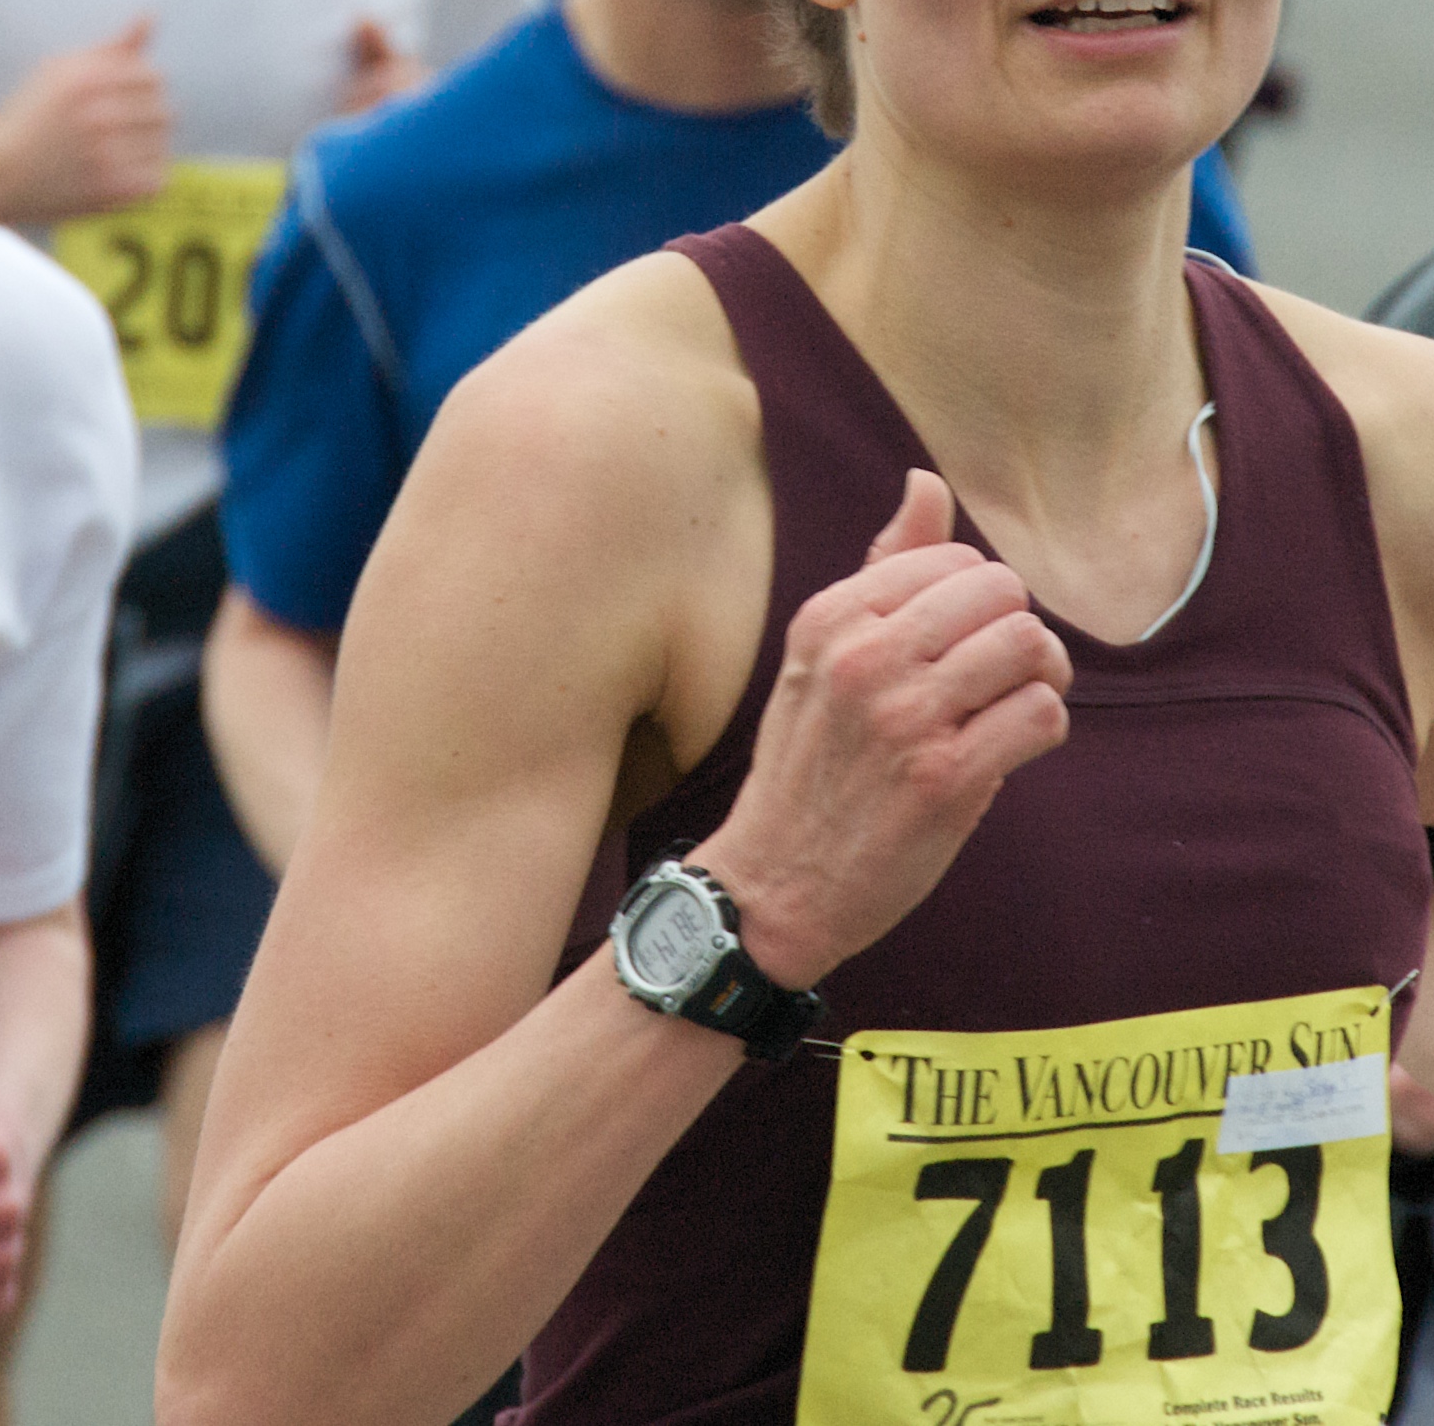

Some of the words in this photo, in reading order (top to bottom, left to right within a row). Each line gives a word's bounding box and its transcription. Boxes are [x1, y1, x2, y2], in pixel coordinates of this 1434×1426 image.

[891, 1054, 999, 1126] THE
[1013, 1037, 1272, 1122] VANCOUVER
[901, 1138, 1329, 1373] 7113
[1164, 1399, 1230, 1417] Complete
[1232, 1395, 1267, 1410] Race
[1270, 1388, 1325, 1405] Results
